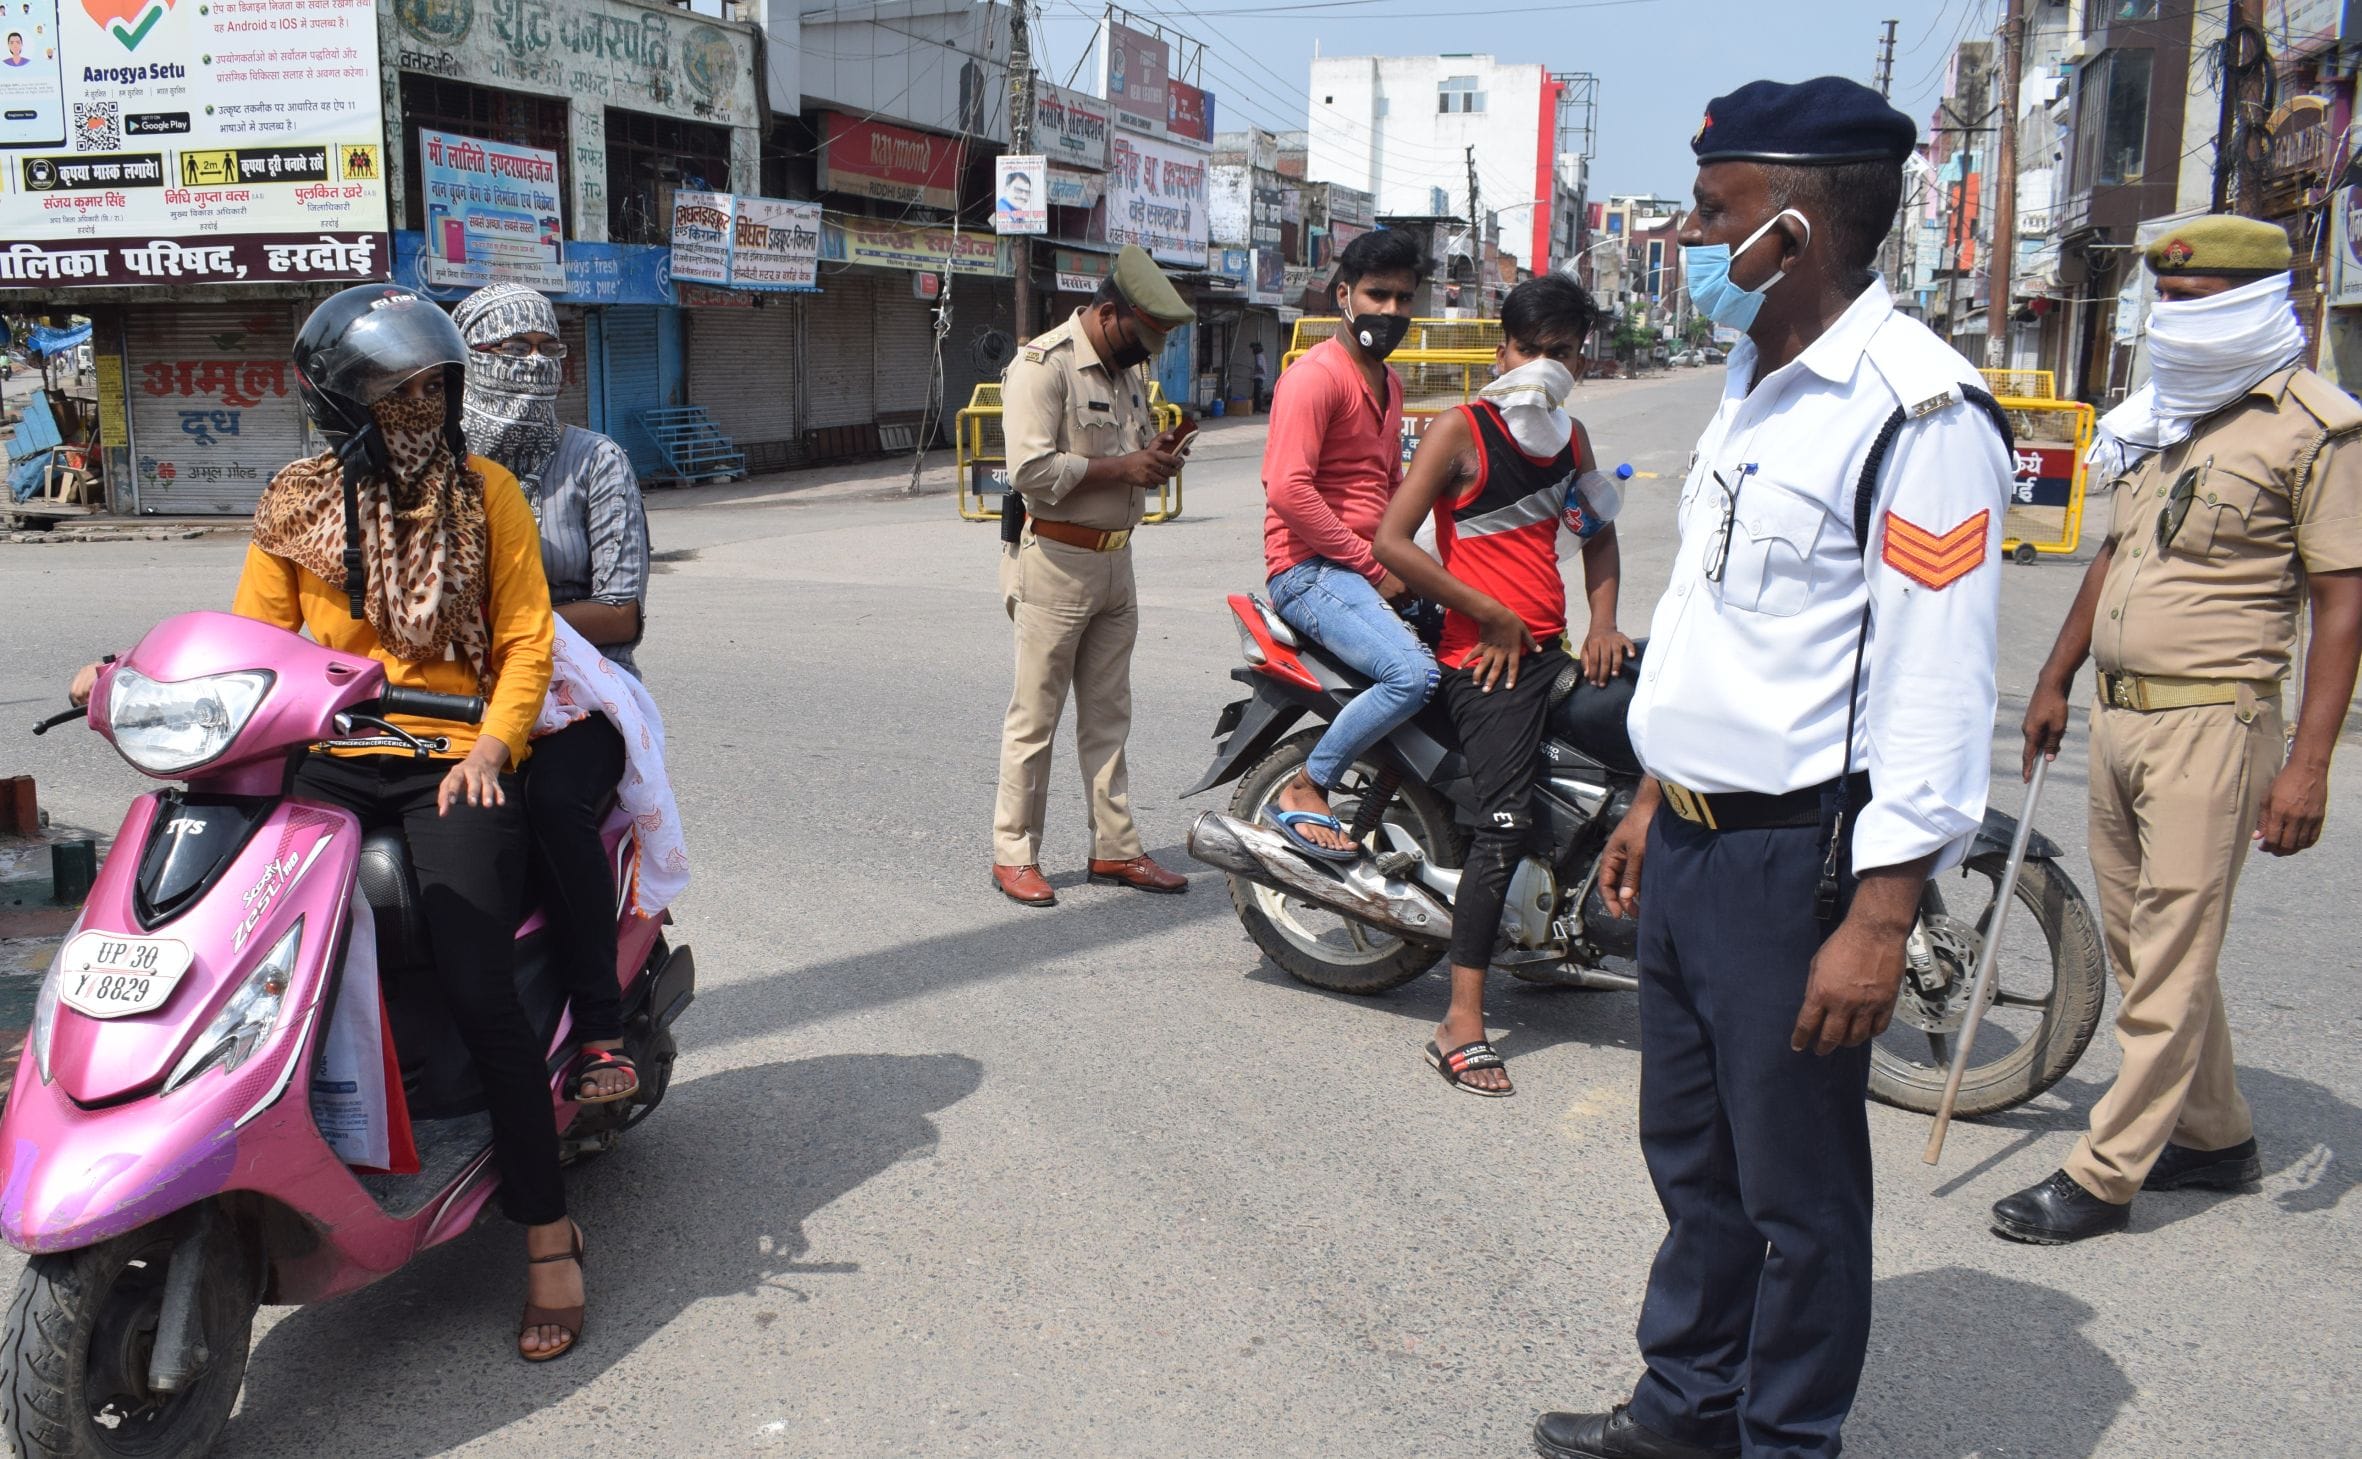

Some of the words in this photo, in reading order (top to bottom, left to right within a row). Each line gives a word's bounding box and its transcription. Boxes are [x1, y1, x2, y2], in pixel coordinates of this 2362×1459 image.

[227, 19, 268, 32] Android
[279, 18, 298, 30] IOS
[83, 65, 147, 84] Aarogya
[150, 62, 186, 79] Setu
[141, 121, 170, 132] Google
[170, 120, 188, 130] Play
[58, 164, 90, 187] कृपया
[92, 163, 121, 180] मास्क
[203, 161, 218, 171] 2m
[240, 157, 265, 178] कृपया
[267, 155, 282, 177] दूरी
[164, 187, 193, 205] निधि
[194, 189, 223, 209] गुप्ता
[225, 188, 250, 202] वत्स
[295, 183, 339, 206] पुलकित
[341, 182, 363, 199] खरे
[868, 181, 895, 199] RIDDHI
[43, 193, 72, 210] संजय
[74, 195, 104, 213] कुमार
[105, 191, 126, 208] सिंह
[307, 200, 351, 212] जिलाधिकारी
[170, 208, 188, 221] मुख्य
[216, 206, 248, 217] अधिकारी
[320, 218, 339, 229] हरदोई
[77, 224, 96, 235] हरदोई
[199, 220, 218, 231] हरदोई
[263, 234, 376, 276] हरदोई
[142, 360, 290, 409] अमूल
[178, 410, 241, 446] दूध
[188, 465, 222, 484] अमूल
[227, 461, 258, 480] गोल्ड
[166, 818, 208, 835] TVS
[241, 857, 285, 911] Scooty
[97, 941, 128, 965] UP
[128, 945, 160, 970] 30
[96, 974, 151, 1003] 8829
